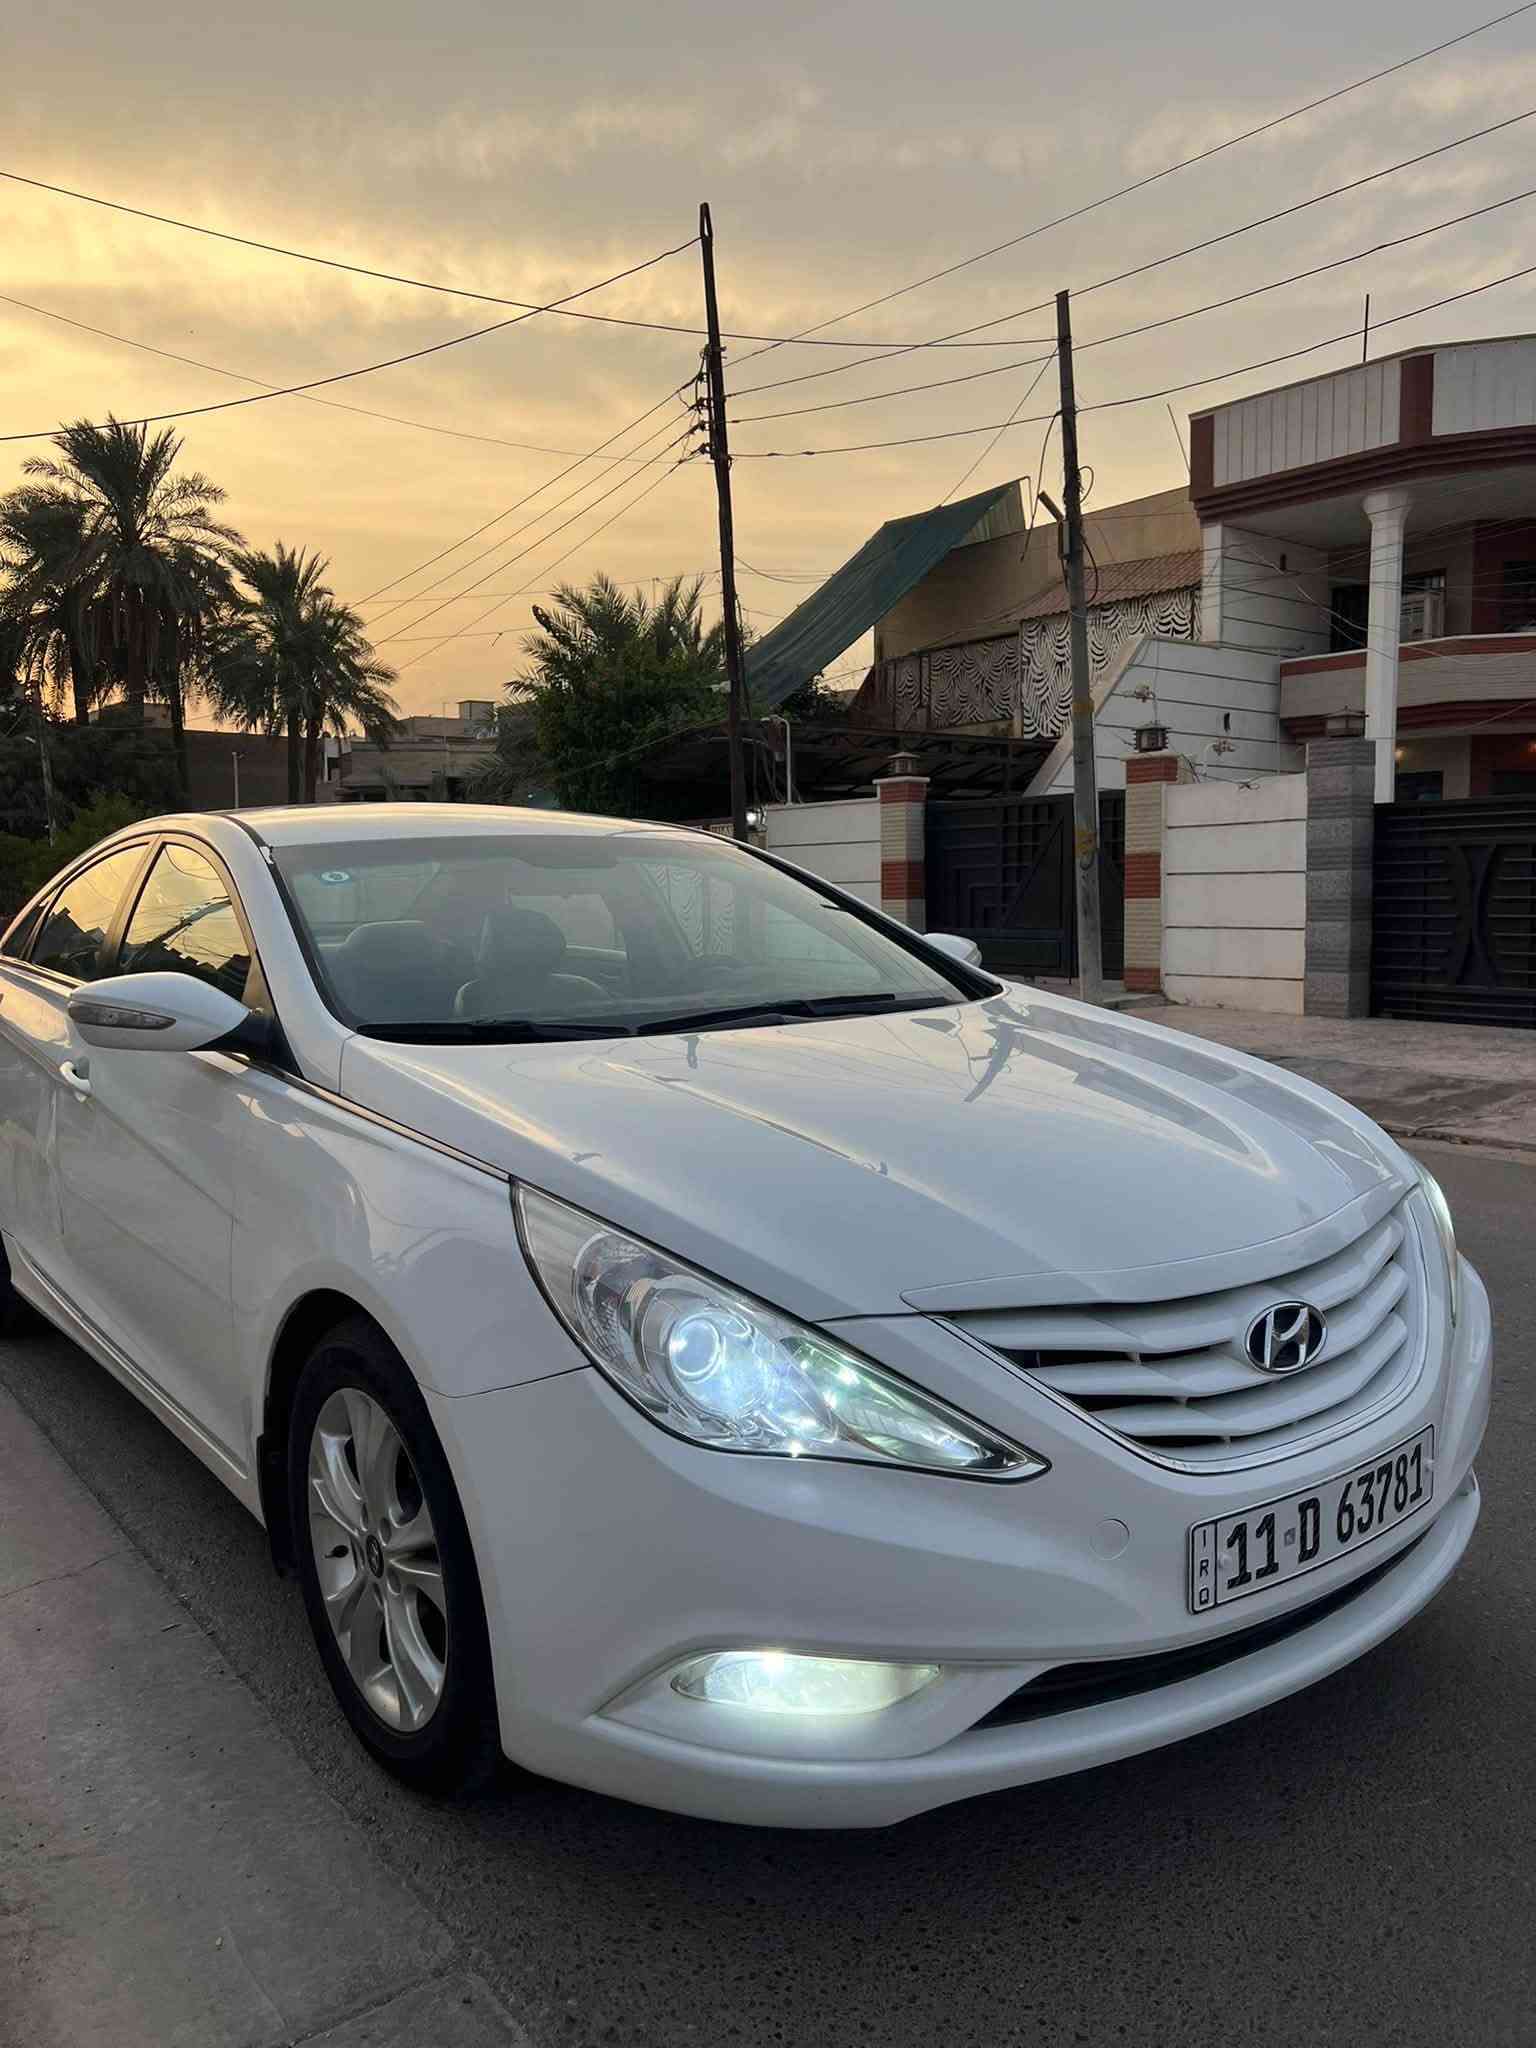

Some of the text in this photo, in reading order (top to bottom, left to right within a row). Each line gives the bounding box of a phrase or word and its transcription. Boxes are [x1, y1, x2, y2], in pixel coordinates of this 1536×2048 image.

[1226, 1443, 1423, 1590] 11 D 63781
